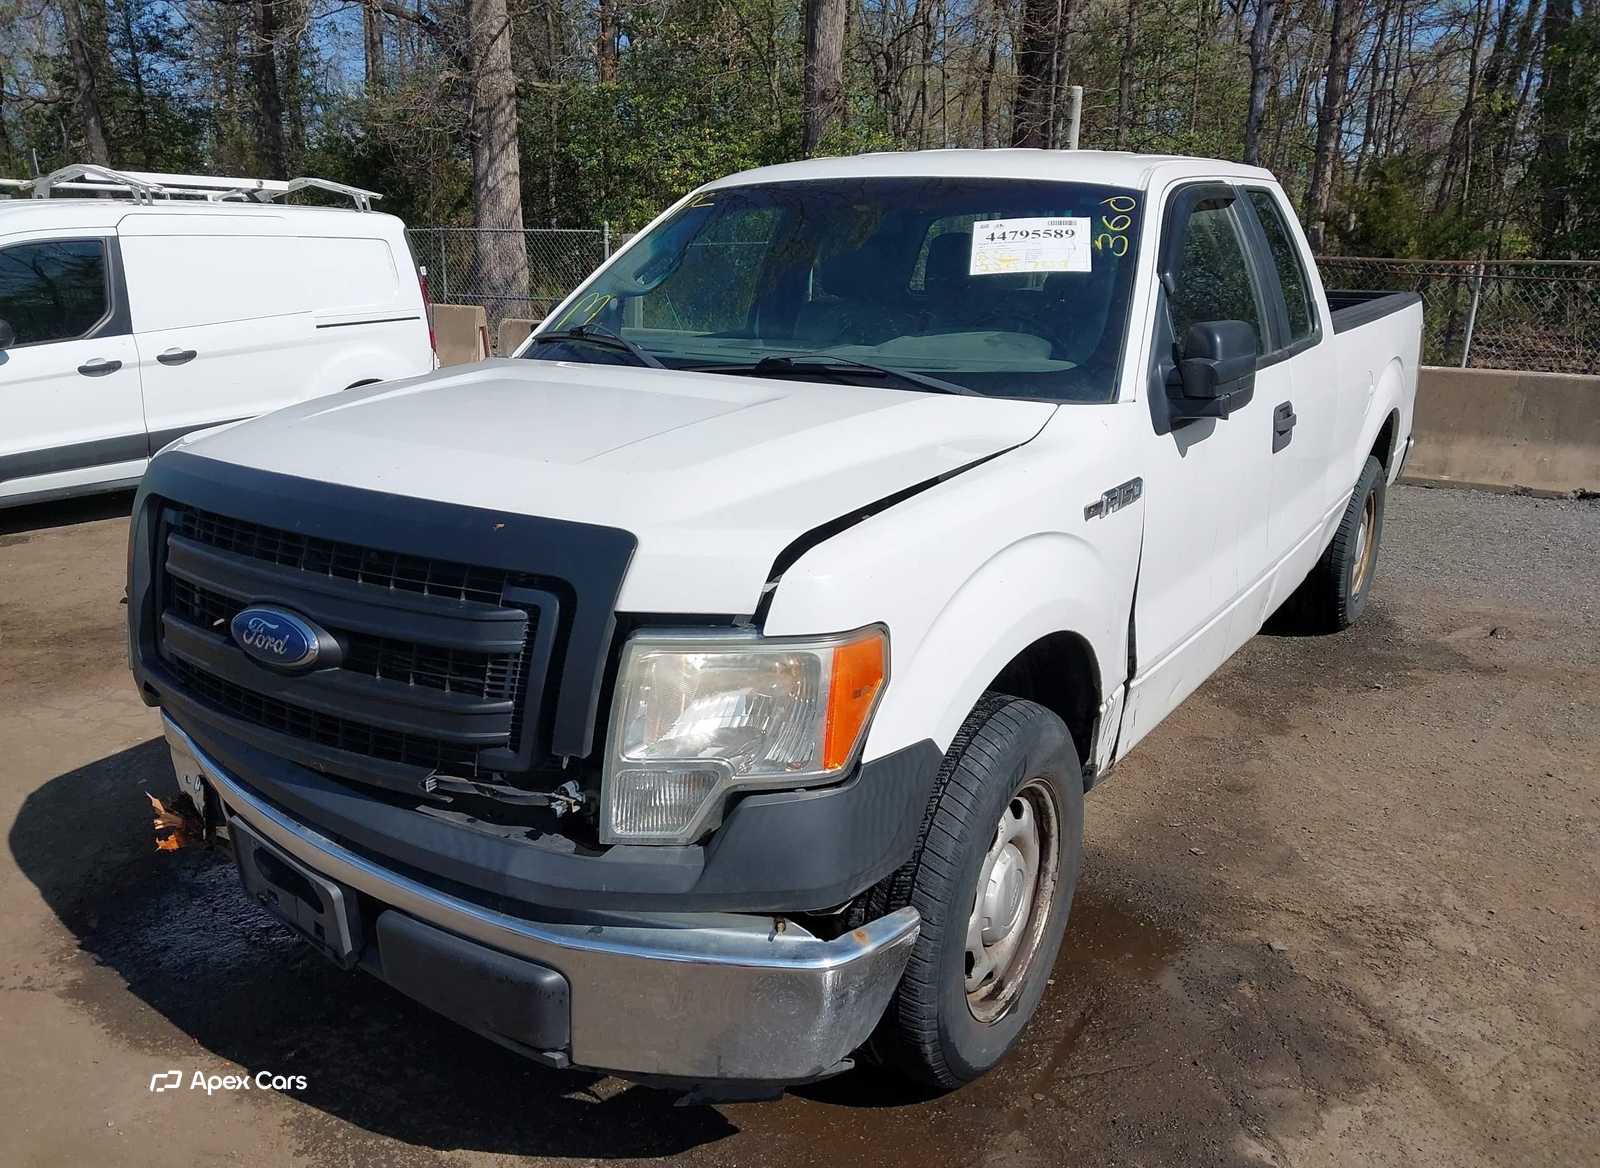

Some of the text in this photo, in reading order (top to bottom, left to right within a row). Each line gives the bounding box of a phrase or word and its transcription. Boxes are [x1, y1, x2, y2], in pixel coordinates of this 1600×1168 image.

[985, 228, 1076, 242] 44795589
[1094, 195, 1136, 257] 360
[243, 617, 290, 655] Ford
